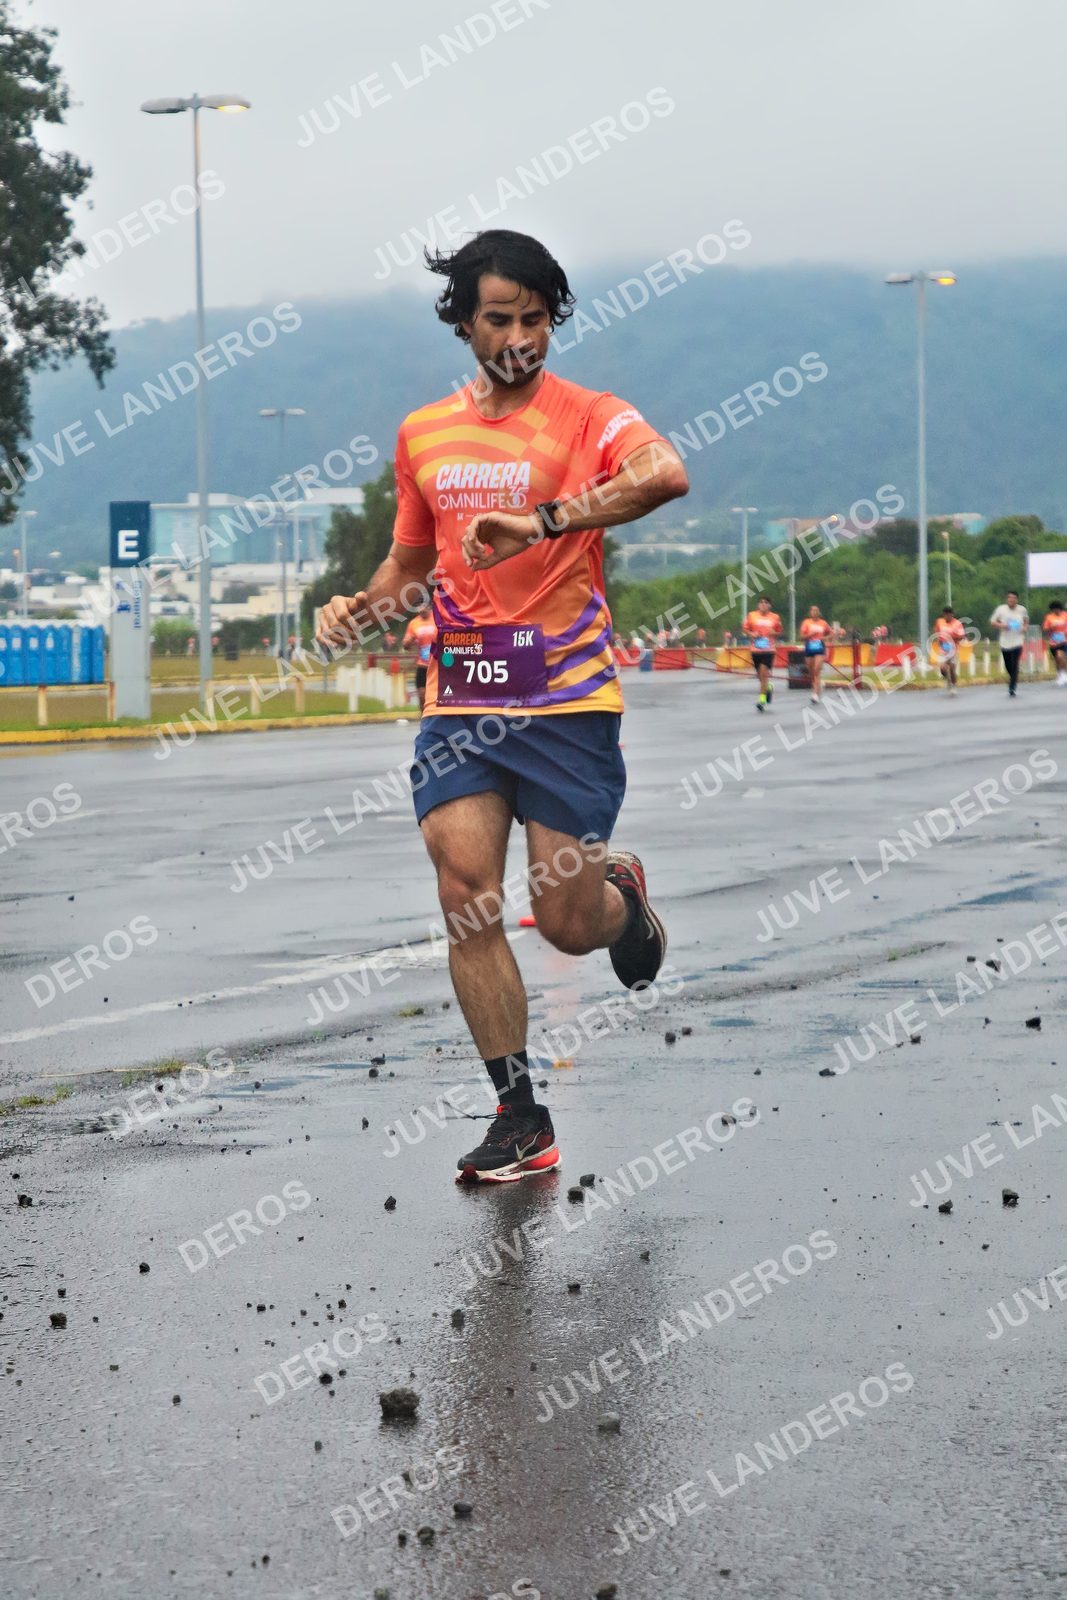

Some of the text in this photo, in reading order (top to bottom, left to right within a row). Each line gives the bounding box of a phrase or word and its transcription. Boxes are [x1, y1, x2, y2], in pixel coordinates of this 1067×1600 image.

[436, 461, 531, 490] CARRERA
[438, 492, 506, 510] OMNILIFE
[118, 529, 140, 560] E
[443, 632, 483, 646] CARRERA
[463, 660, 508, 684] 705
